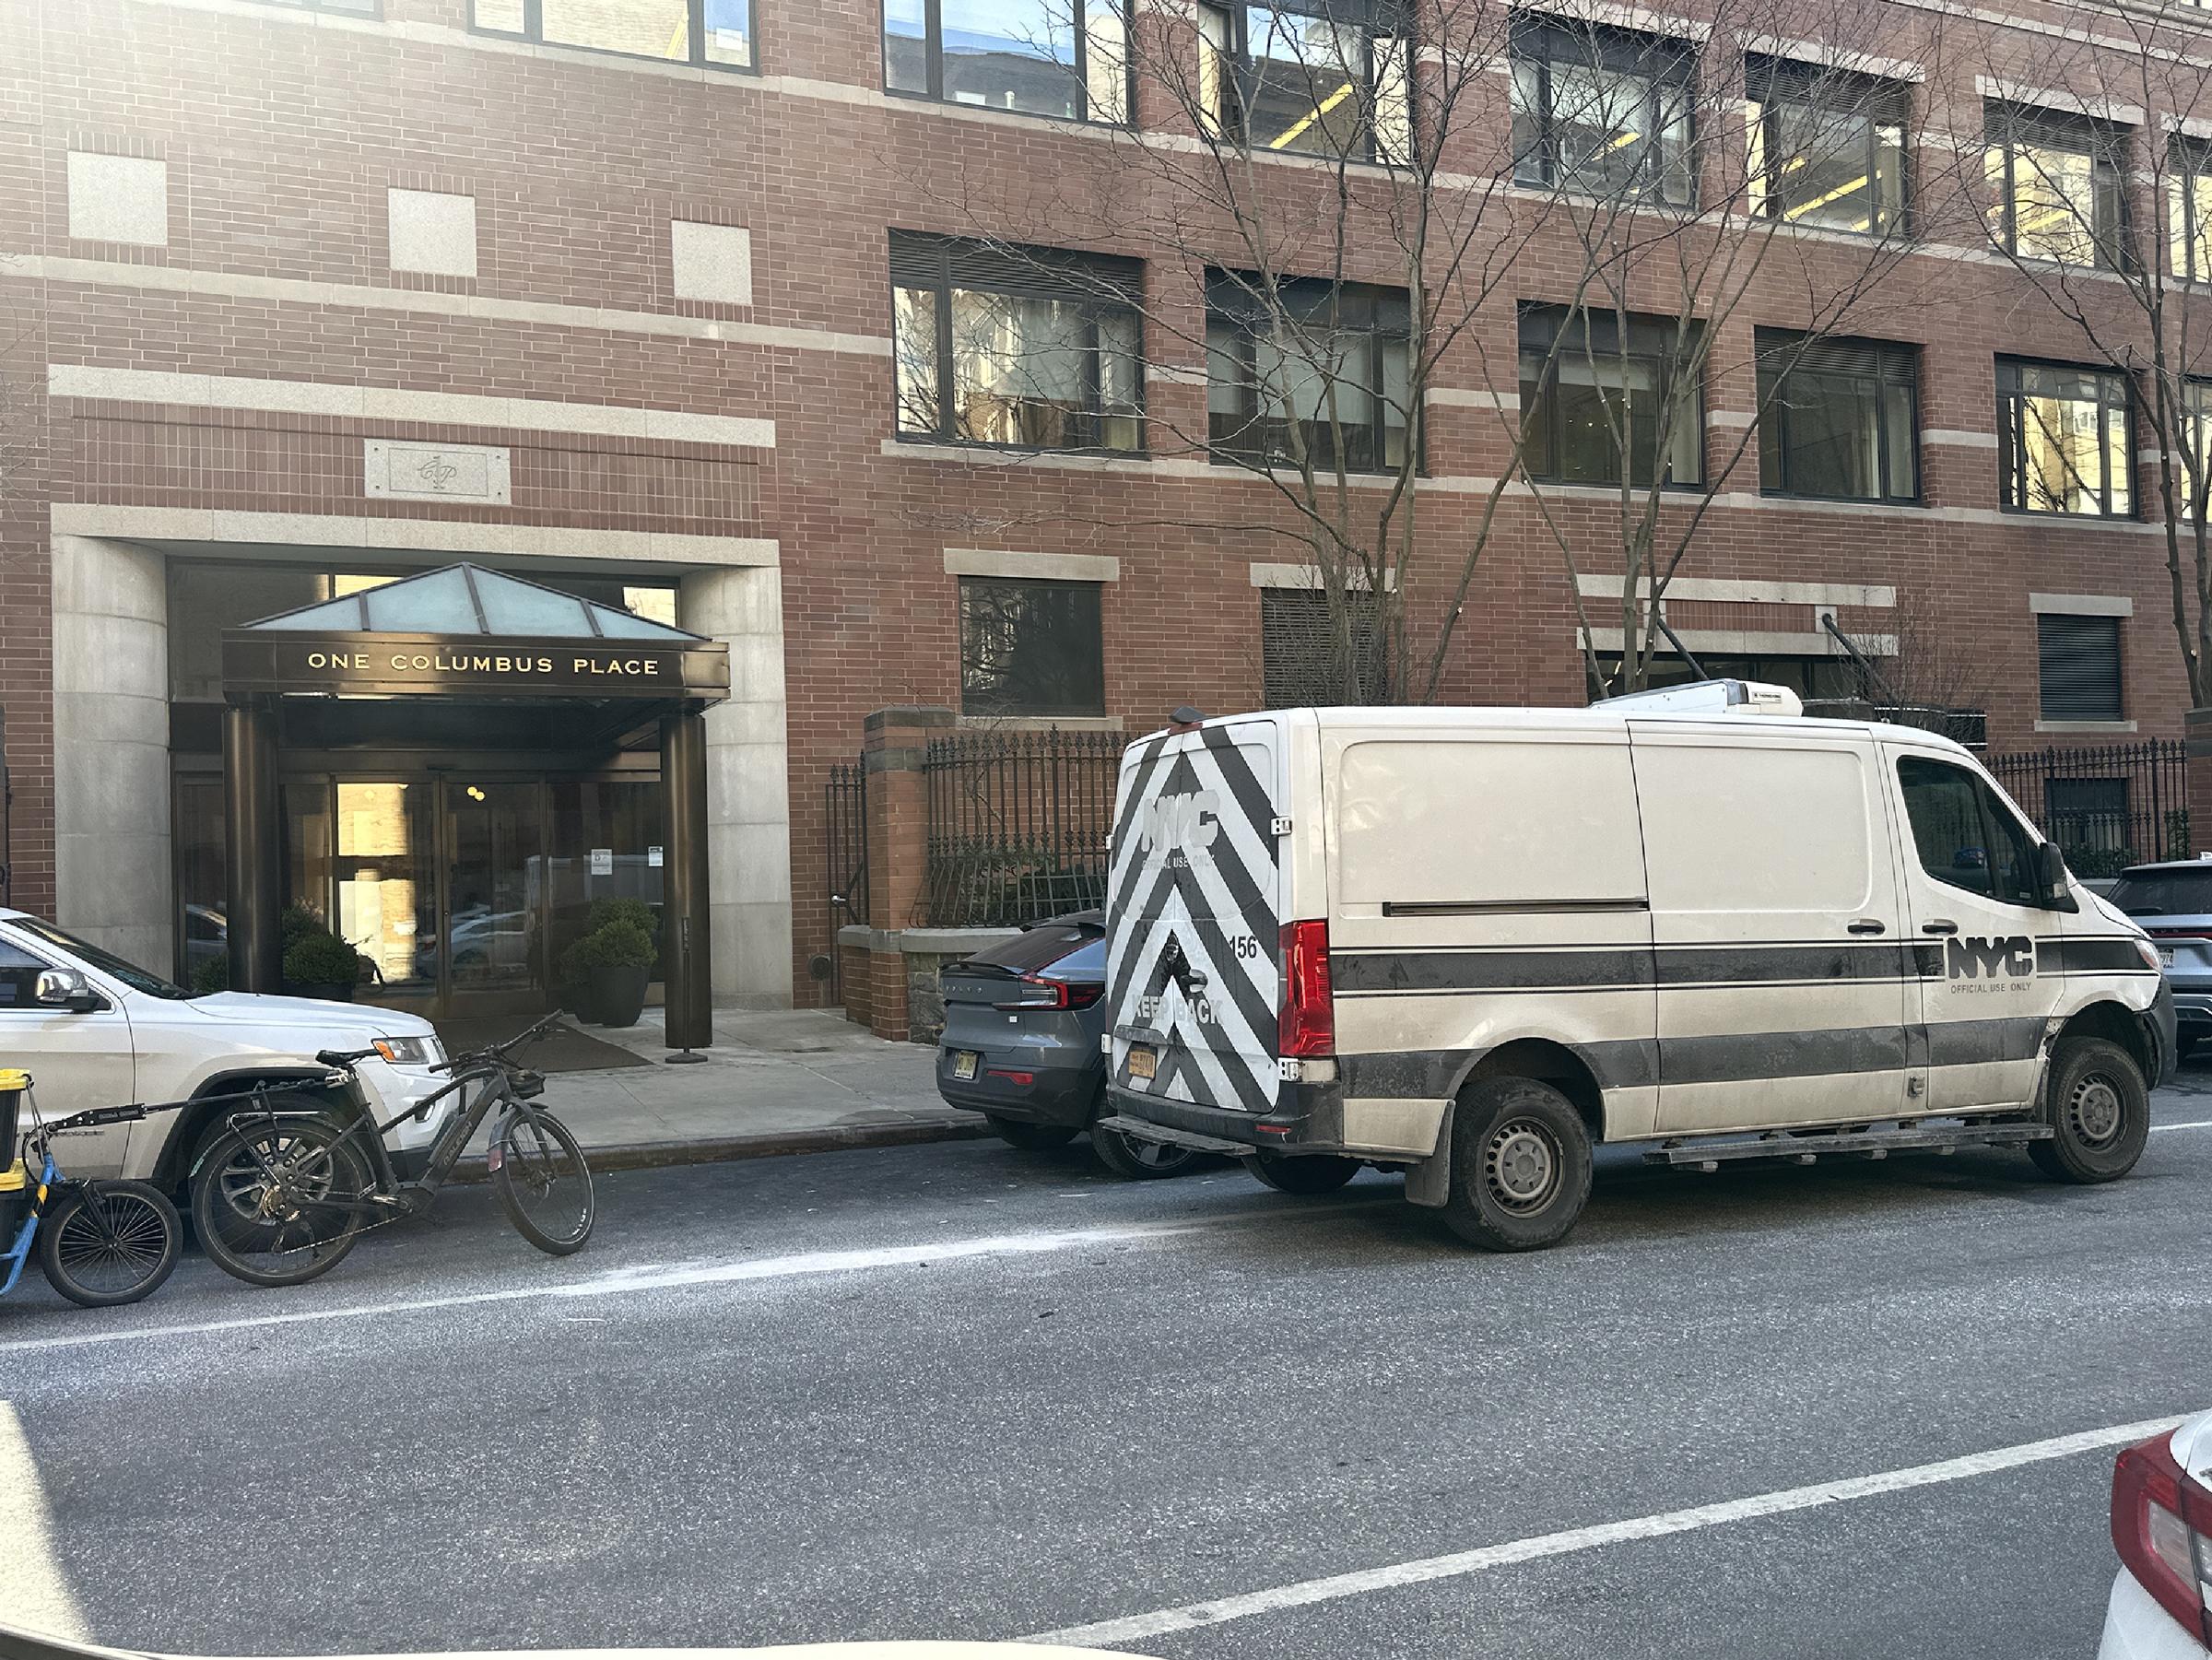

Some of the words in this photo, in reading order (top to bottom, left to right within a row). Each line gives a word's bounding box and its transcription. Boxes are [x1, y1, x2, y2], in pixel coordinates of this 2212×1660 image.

[308, 653, 370, 669] ONE
[391, 654, 553, 673] COLUMBUS
[573, 658, 659, 676] PLACE
[1141, 789, 1220, 853] NYC
[1173, 856, 1188, 868] USE
[1229, 935, 1257, 960] 156
[1947, 936, 2033, 980] NYC
[1950, 984, 1987, 995] OFFICIAL
[1991, 983, 2006, 993] USE
[2011, 982, 2031, 992] ONLY
[1133, 995, 1170, 1020] KEEP
[1175, 998, 1223, 1025] BACK
